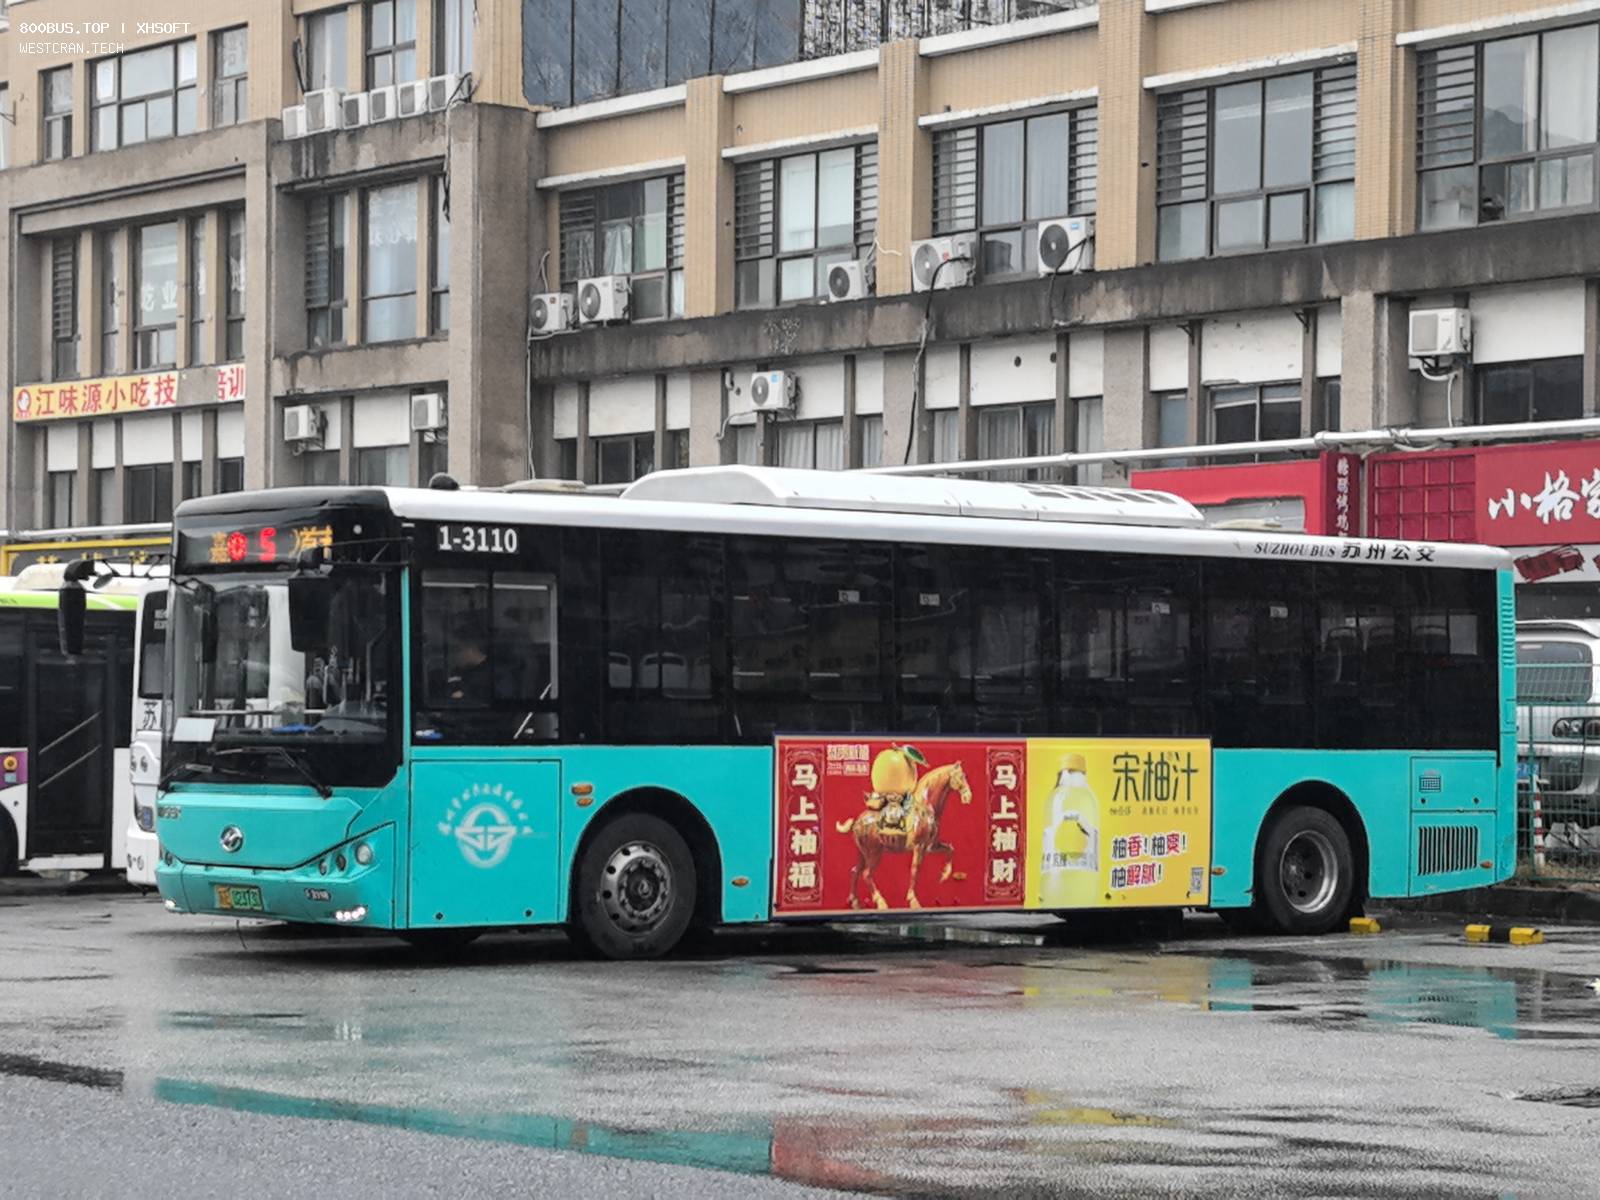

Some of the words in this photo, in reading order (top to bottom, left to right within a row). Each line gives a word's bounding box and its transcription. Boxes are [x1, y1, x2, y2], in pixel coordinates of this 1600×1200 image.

[36, 374, 176, 416] 江味源小吃技
[439, 525, 518, 553] 1-3110
[1254, 542, 1309, 557] SUZHOU
[1309, 545, 1336, 559] BUS
[1340, 541, 1437, 563] 苏州公交
[1112, 751, 1199, 803] 宋柚汁
[788, 763, 819, 888] 马上柚福
[991, 764, 1019, 883] 马上柚财
